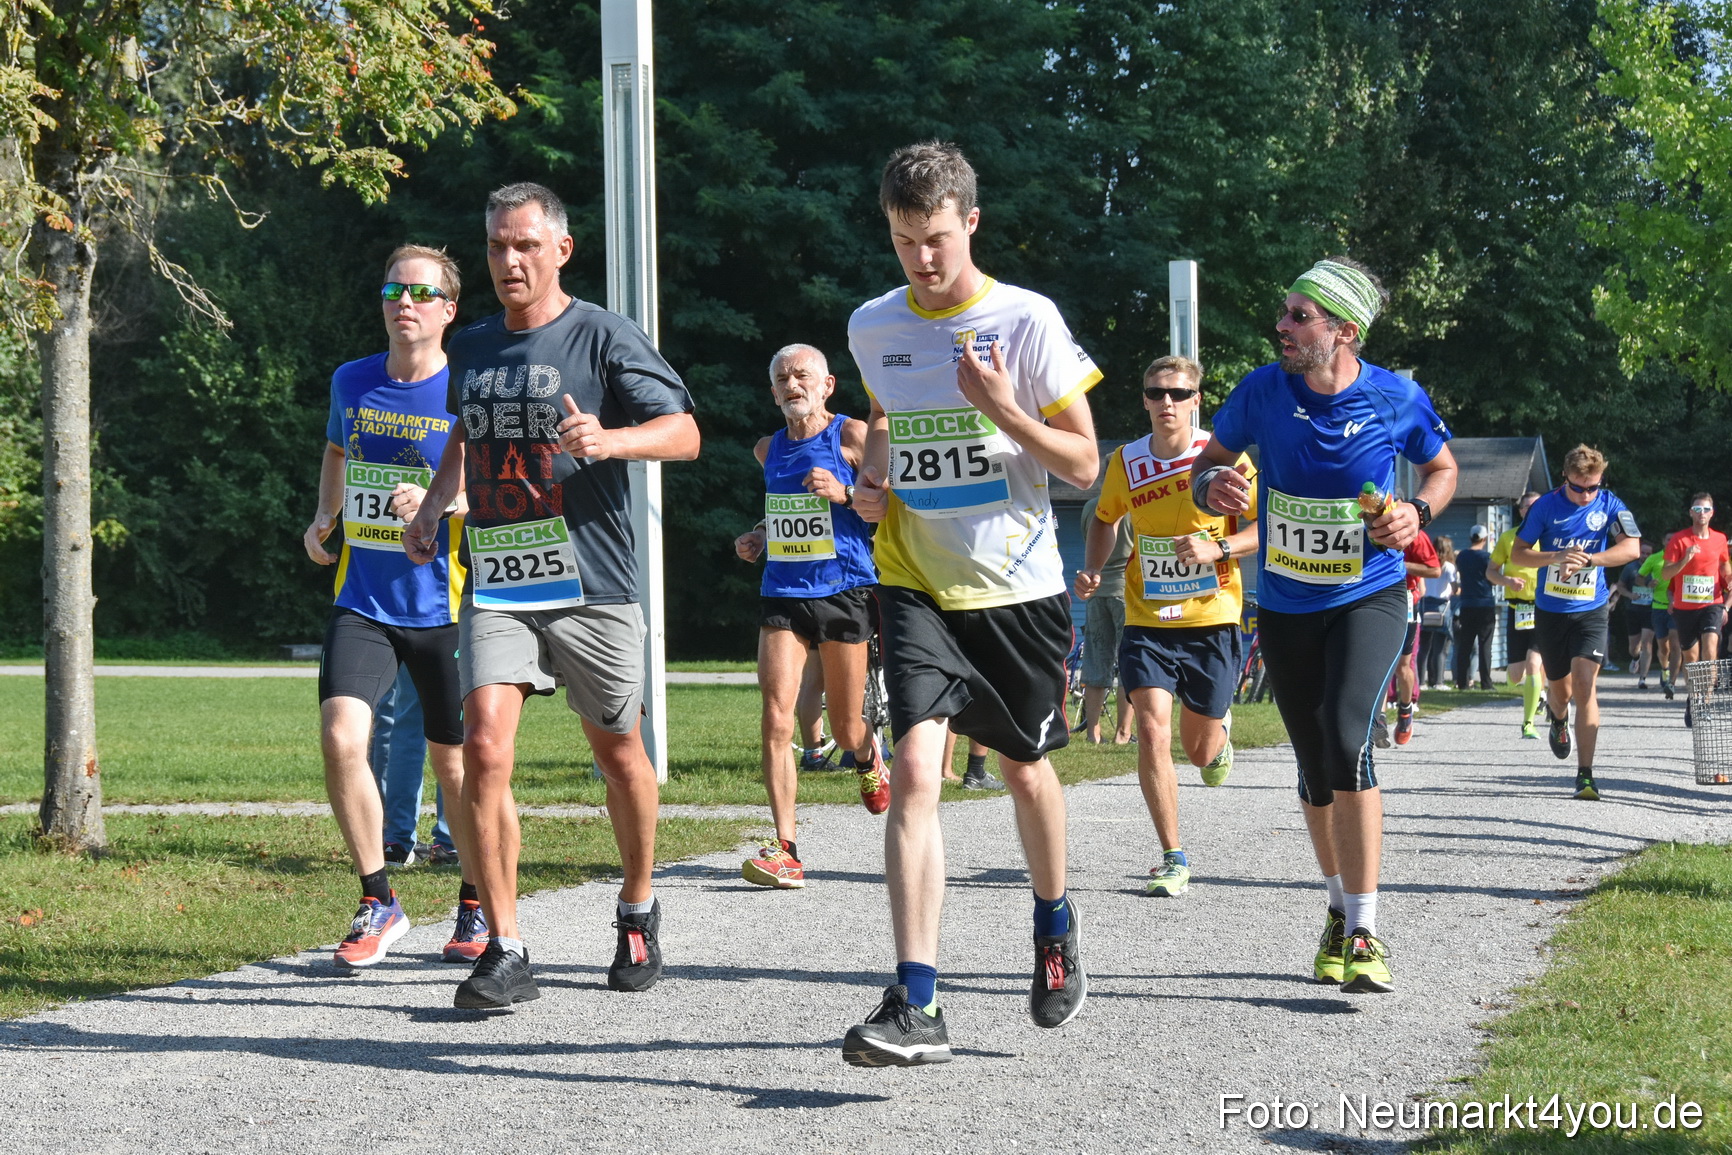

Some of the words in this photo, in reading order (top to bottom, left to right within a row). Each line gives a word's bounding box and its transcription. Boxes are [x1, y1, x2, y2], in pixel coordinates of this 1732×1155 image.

[883, 355, 911, 363] BOCK
[462, 364, 562, 401] MUD
[345, 407, 355, 419] 10.
[357, 407, 450, 434] NEUMARKTER
[353, 419, 428, 442] STADTLAUF
[462, 403, 560, 440] DER
[893, 412, 982, 438] BOCK
[900, 444, 990, 483] 2815
[352, 466, 419, 487] BOCK
[471, 483, 564, 520] ION
[769, 497, 819, 511] BOCK
[906, 489, 940, 509] Andy
[1131, 485, 1171, 508] MAX
[1274, 500, 1350, 520] BOCK
[356, 525, 405, 541] JÜRGE
[478, 521, 558, 547] BOCK
[772, 517, 824, 538] 1006
[1276, 522, 1351, 554] 1134
[782, 544, 811, 554] WILLI
[484, 550, 565, 584] 2825
[1274, 553, 1352, 574] JOHANNES
[1160, 582, 1200, 593] JULIAN
[1553, 586, 1587, 595] MICHAEL
